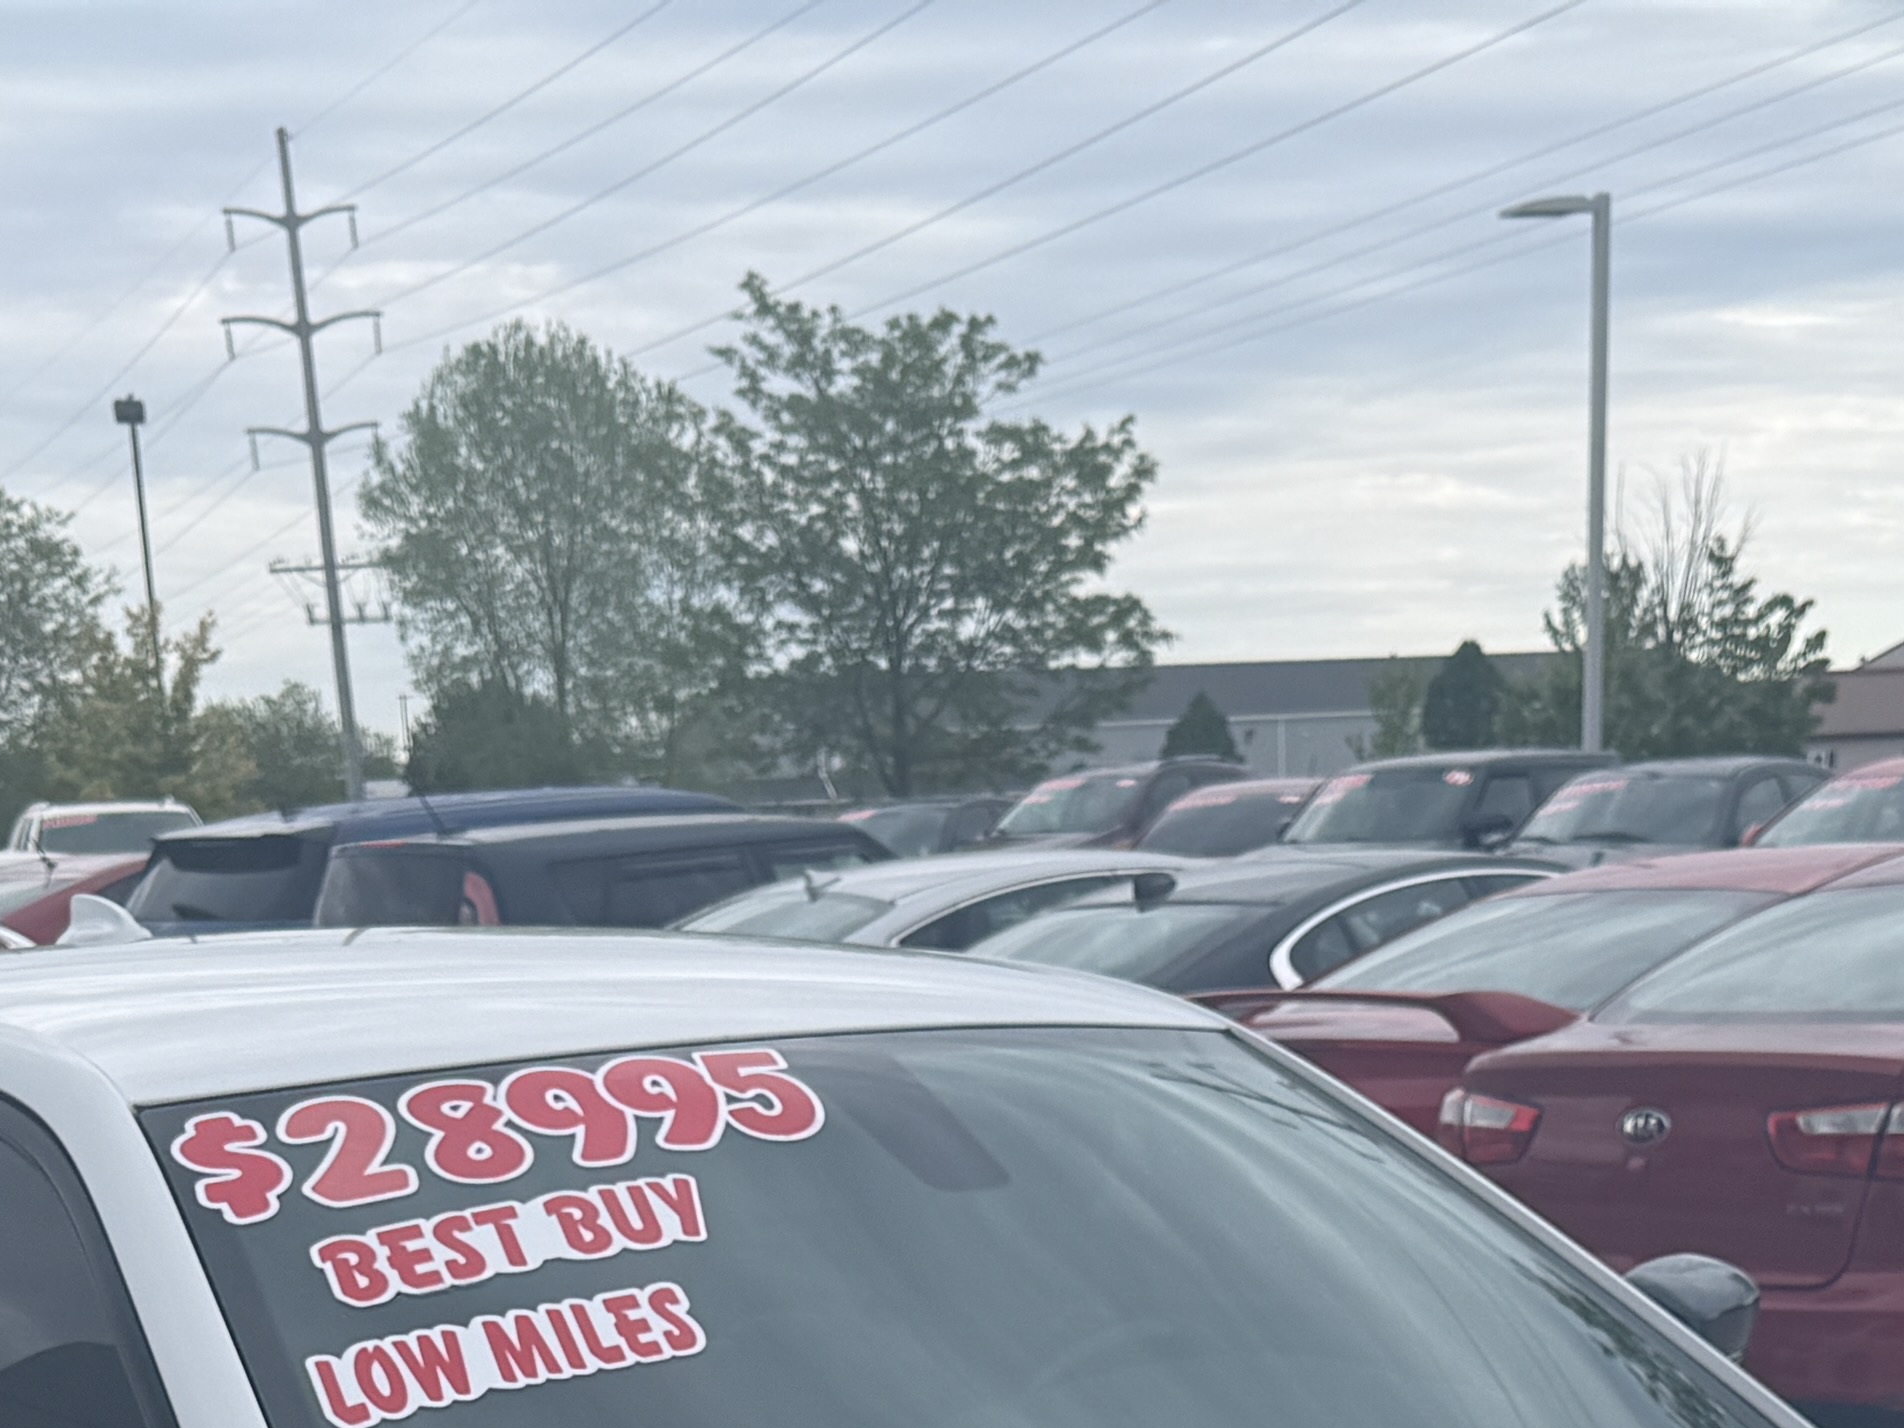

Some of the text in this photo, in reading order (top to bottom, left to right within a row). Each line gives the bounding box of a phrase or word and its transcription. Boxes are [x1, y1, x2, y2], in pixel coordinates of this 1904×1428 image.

[171, 1048, 827, 1226] $28995
[317, 1174, 707, 1305] BEST BUY
[313, 1285, 703, 1427] LOW MILES
